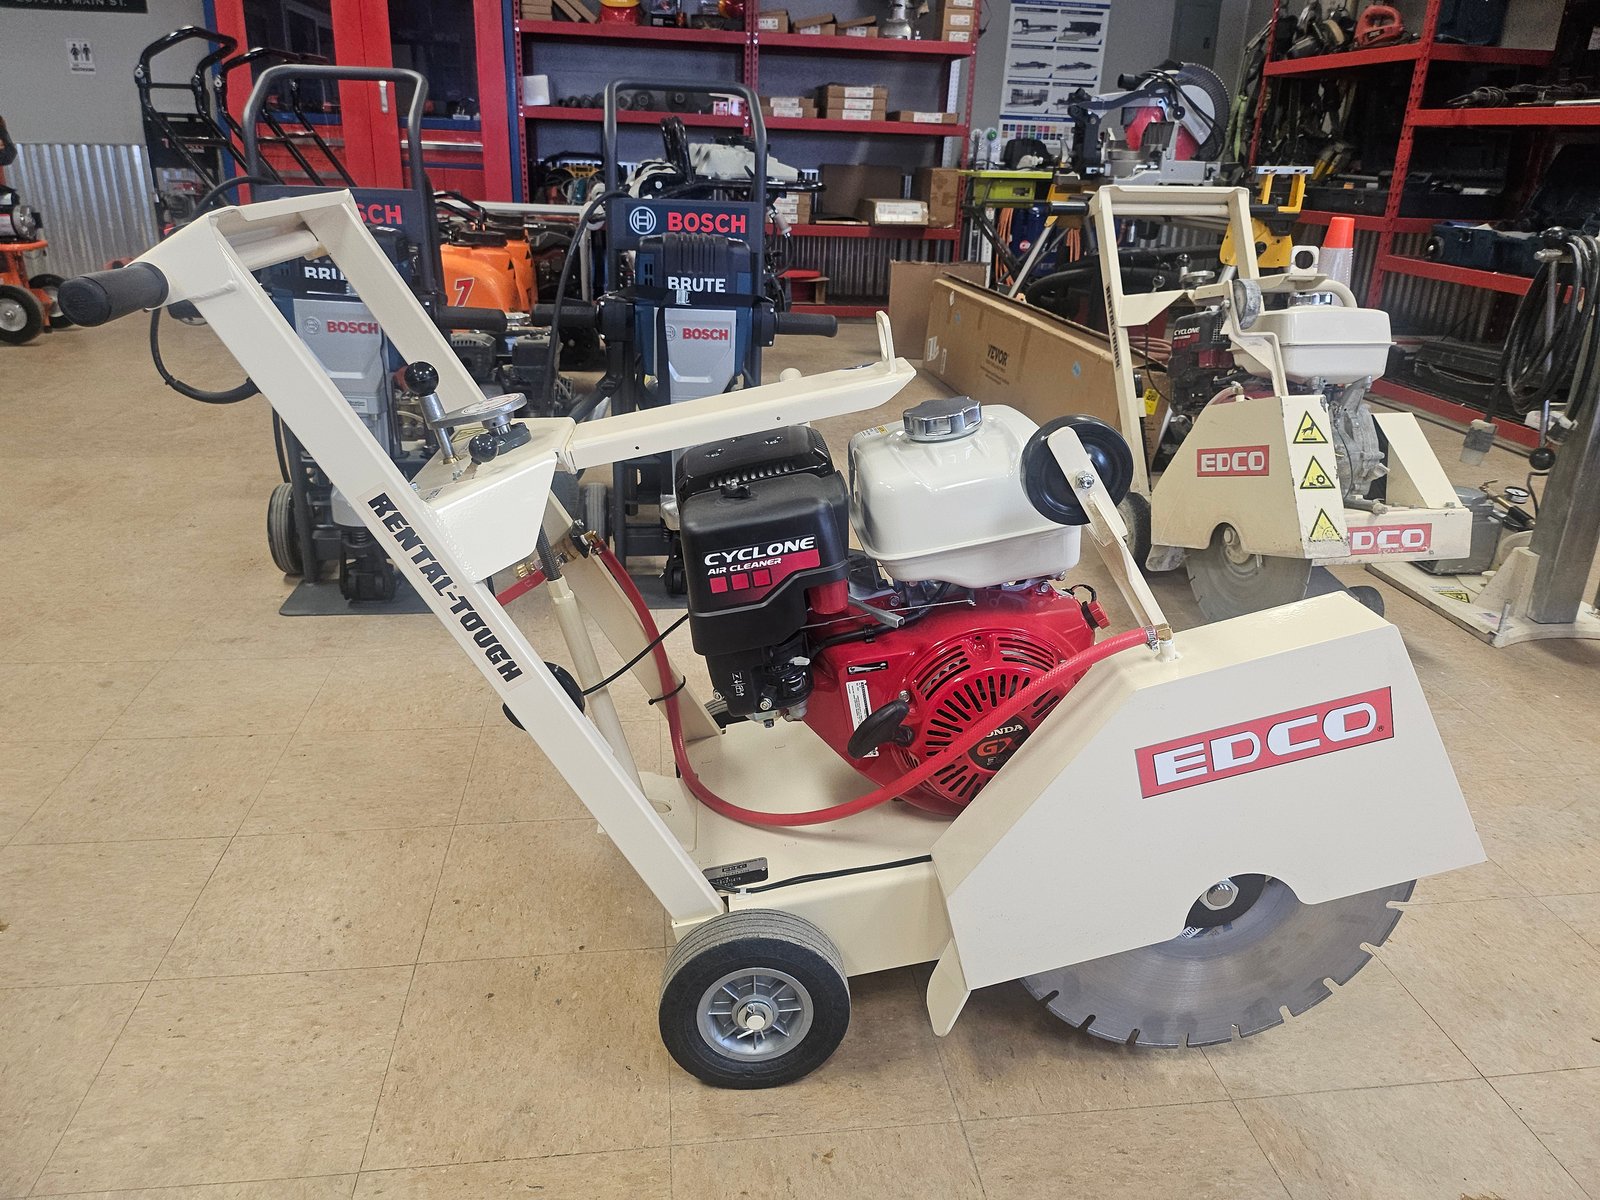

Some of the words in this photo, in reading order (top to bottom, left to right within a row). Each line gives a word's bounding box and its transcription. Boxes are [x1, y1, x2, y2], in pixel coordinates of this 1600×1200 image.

[357, 203, 402, 225] SCH
[667, 212, 746, 233] BOSCH
[304, 266, 347, 280] BRU
[667, 276, 726, 293] BRUTE
[326, 321, 379, 334] BOSCH
[682, 328, 728, 340] BOSCH
[1173, 326, 1200, 336] CYCLONE
[1201, 451, 1264, 472] EDCO
[1347, 528, 1426, 551] DCO
[704, 536, 815, 566] CYCLONE
[708, 566, 727, 575] AIR
[729, 558, 782, 572] CLEANER
[368, 492, 523, 683] RENTAL-TOUGH
[1153, 702, 1378, 786] EDCO
